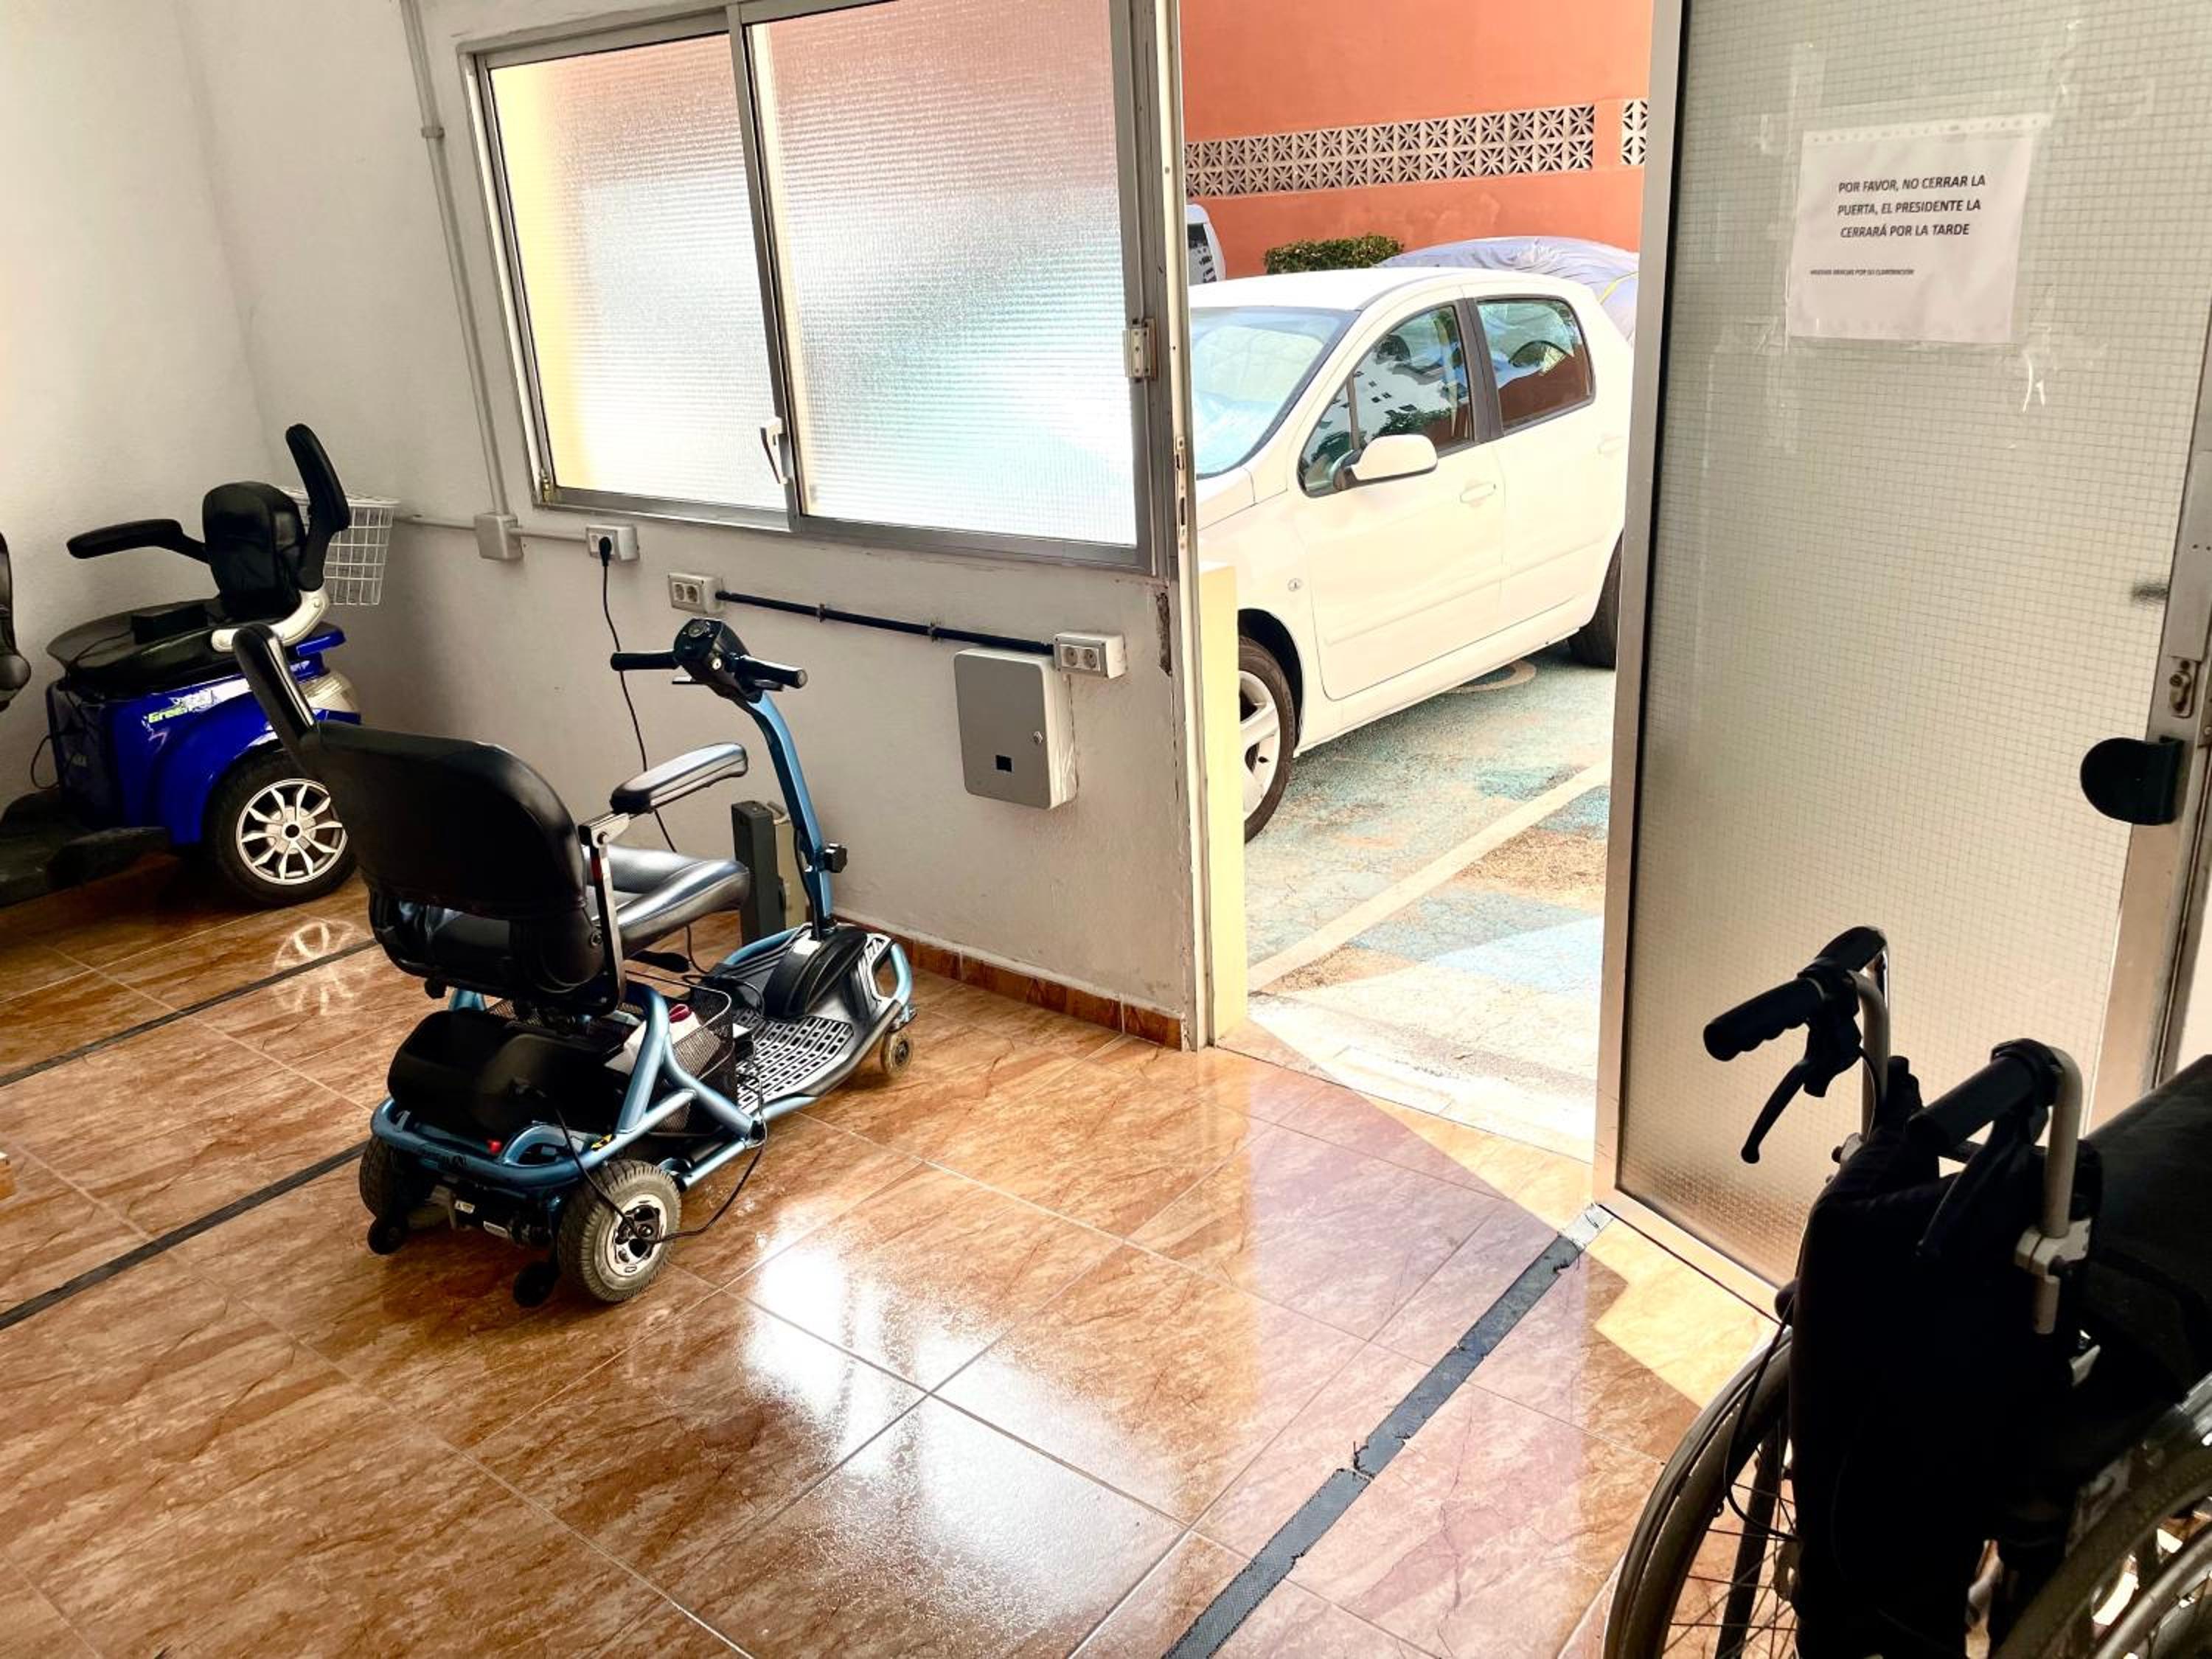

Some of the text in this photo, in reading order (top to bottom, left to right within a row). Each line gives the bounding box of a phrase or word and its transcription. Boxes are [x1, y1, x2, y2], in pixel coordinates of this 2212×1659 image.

[1839, 175, 1986, 192] POR FAVOR, NO CERRAR LA
[1837, 199, 1981, 216] PUERTA, EL PRESIDENTE LA
[1840, 223, 1970, 238] CERRARÁ POR LA TARDE
